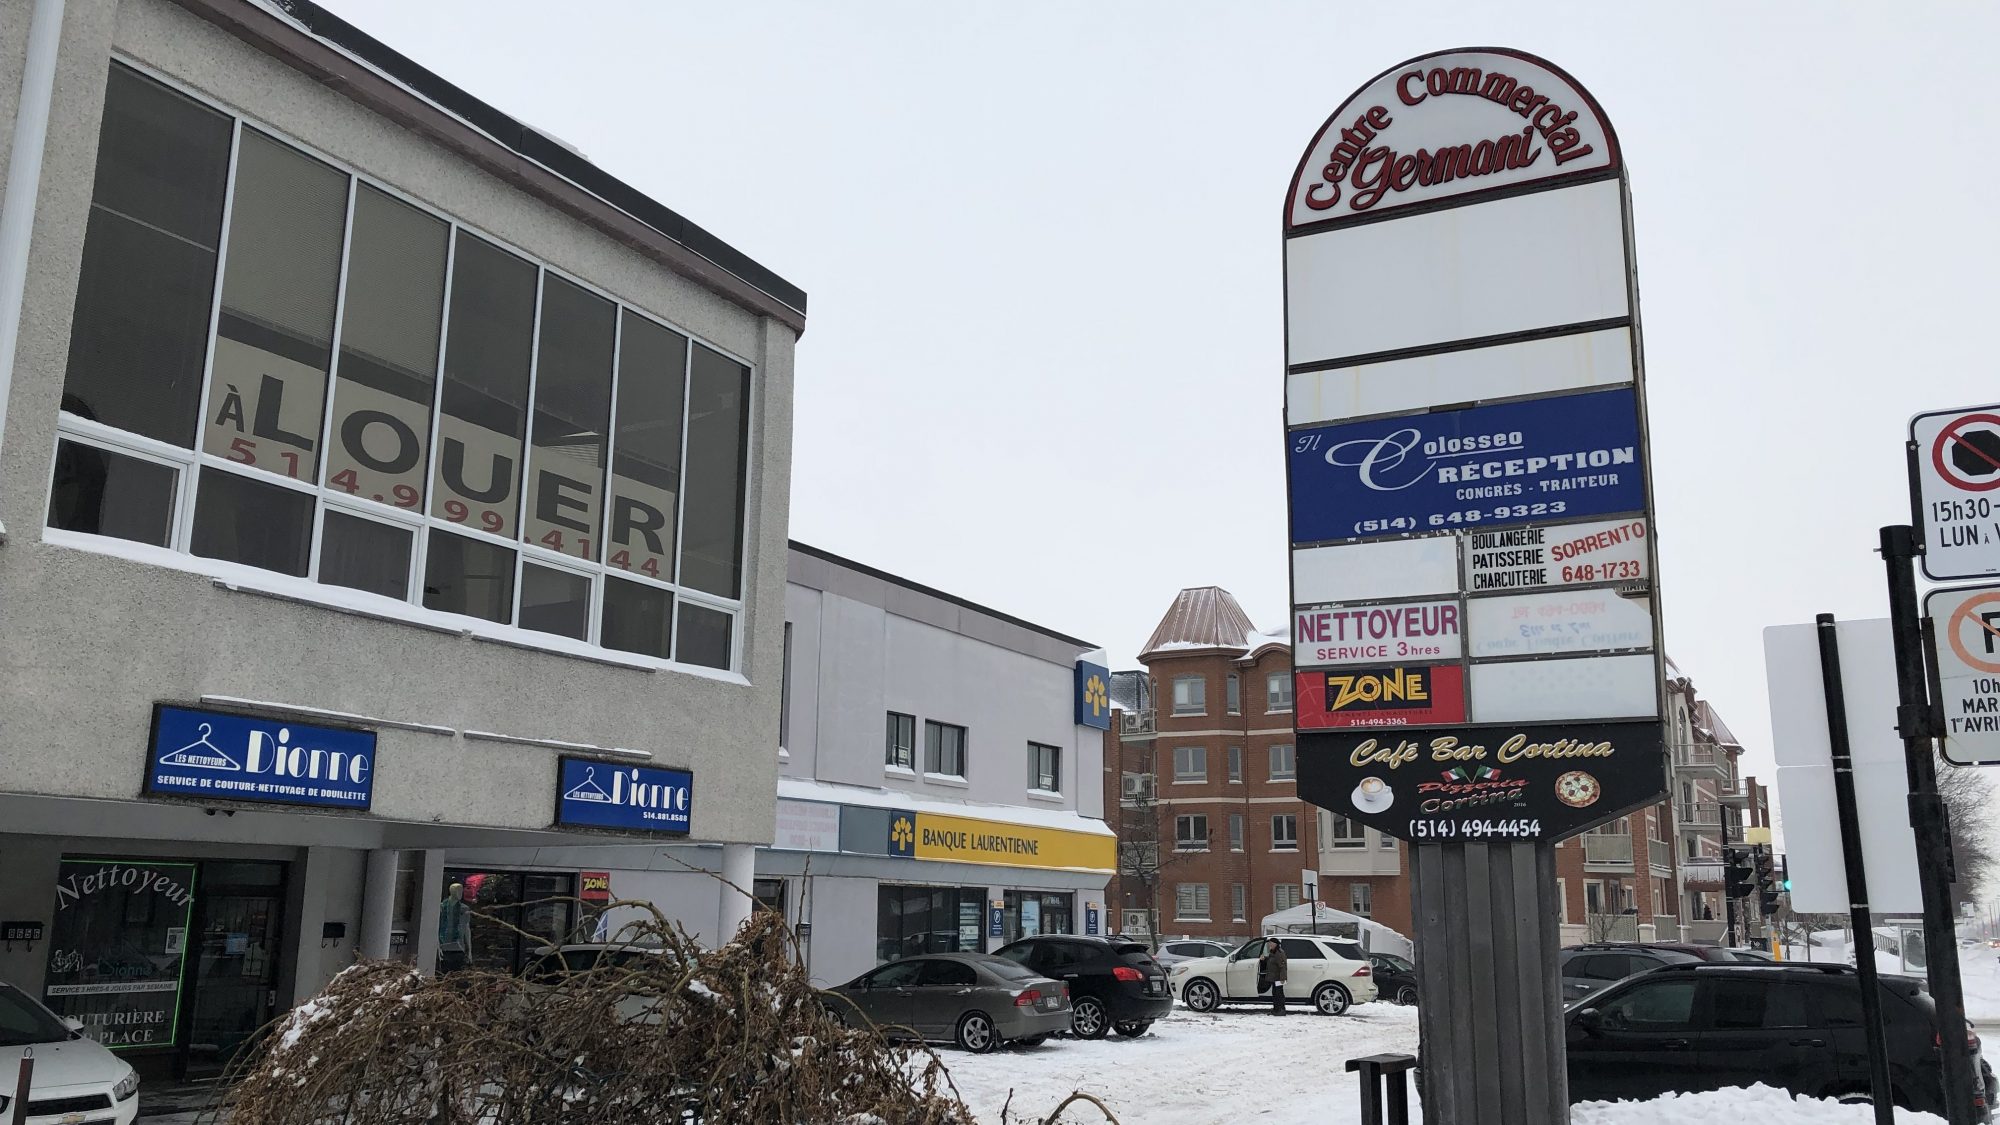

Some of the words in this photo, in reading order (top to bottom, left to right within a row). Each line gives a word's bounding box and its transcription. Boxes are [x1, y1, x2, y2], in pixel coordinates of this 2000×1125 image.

[1305, 105, 1393, 211] Centre
[1397, 67, 1593, 166] Commercial
[1350, 126, 1542, 211] Germani
[214, 384, 245, 433] À
[253, 373, 666, 556] LOUER
[1324, 428, 1524, 491] Colosseo
[1438, 446, 1635, 484] RÉCEPTION
[1456, 482, 1522, 501] CONGRÈS
[1539, 473, 1619, 493] TRAITEUR
[1354, 516, 1417, 534] (514)
[1429, 501, 1567, 527] 648-9323
[1471, 529, 1546, 550] BOULANGERIE
[1551, 522, 1645, 562] SORRENTO
[1940, 523, 1978, 548] LUN
[1472, 548, 1545, 570] PATISSERIE
[1562, 561, 1640, 583] 648-1733
[1473, 569, 1547, 589] CHARCUTERIE
[1299, 604, 1458, 643] NETTOYEUR
[1317, 645, 1388, 661] SERVICE
[1397, 642, 1408, 657] 3
[1411, 645, 1440, 656] hres
[1328, 668, 1428, 711] ZONE
[1351, 717, 1407, 726] 514-494-3363
[1964, 715, 2000, 733] AVRI
[175, 754, 187, 763] LES
[188, 755, 226, 767] NETTOYEURS
[246, 727, 369, 784] Dionne
[1349, 738, 1420, 770] Café
[1431, 736, 1488, 762] Bar
[1497, 733, 1616, 764] Cortina
[157, 775, 196, 787] SERVICE
[200, 778, 212, 789] DE
[214, 779, 305, 795] COUTURE-NETTOYAGE
[308, 788, 319, 798] DE
[321, 789, 366, 801] DOUILLETTE
[612, 769, 688, 811] Dionne
[1417, 778, 1530, 795] Pizzeria
[1420, 786, 1523, 815] Cortina
[923, 828, 966, 851] BANQUE
[971, 832, 1039, 856] LAURENTIENNE
[1410, 819, 1456, 838] (514)
[1461, 818, 1541, 838] 494-4454
[55, 863, 195, 912] Nettoyeur
[52, 986, 80, 994] SERVICE
[98, 1029, 154, 1044] PLACE
